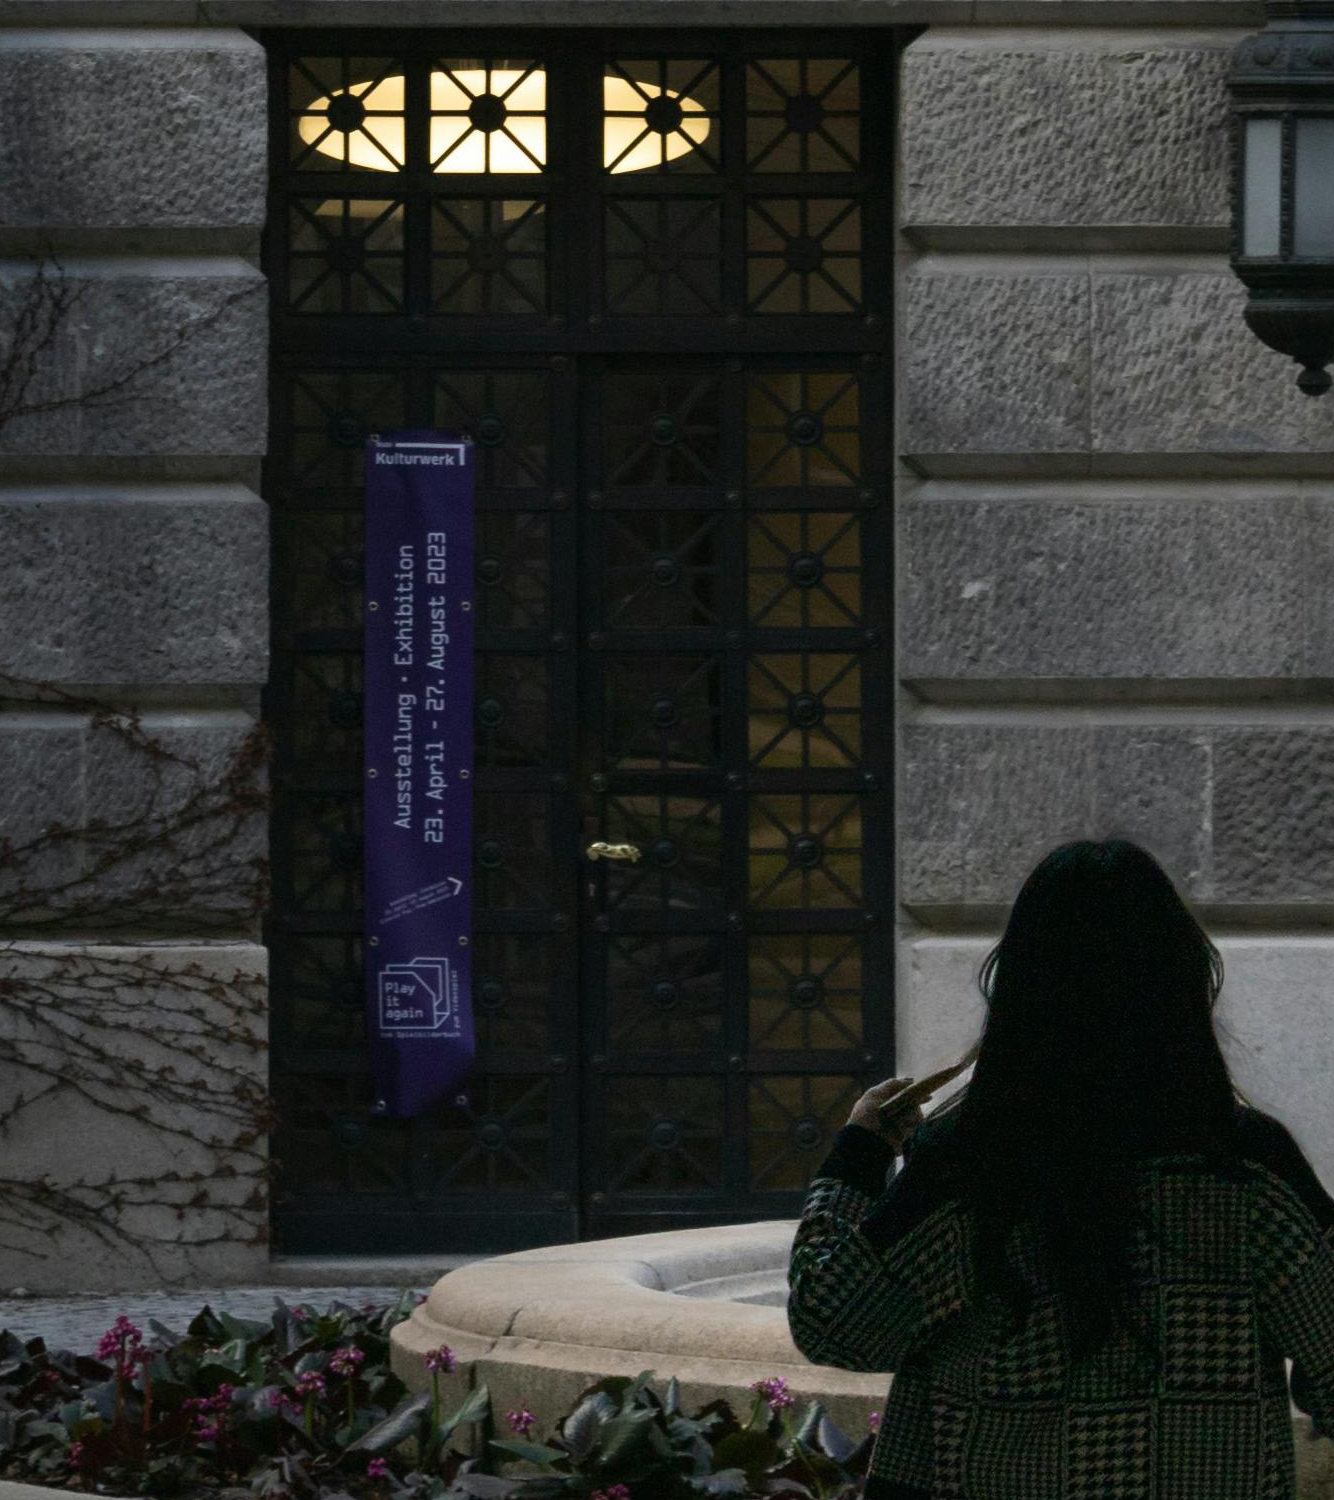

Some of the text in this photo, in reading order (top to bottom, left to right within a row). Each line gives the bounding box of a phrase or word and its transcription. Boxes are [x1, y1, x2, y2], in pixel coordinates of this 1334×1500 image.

[375, 452, 455, 466] Kulturwerk
[426, 532, 446, 585] 2023
[393, 545, 414, 666] Exhibition
[426, 595, 450, 671] August
[425, 679, 446, 711] 27.
[393, 693, 417, 829] Ausstellung
[425, 741, 448, 801] April
[424, 808, 444, 843] 23.
[385, 982, 416, 996] Play
[386, 996, 400, 1007] it
[385, 1006, 424, 1021] again
